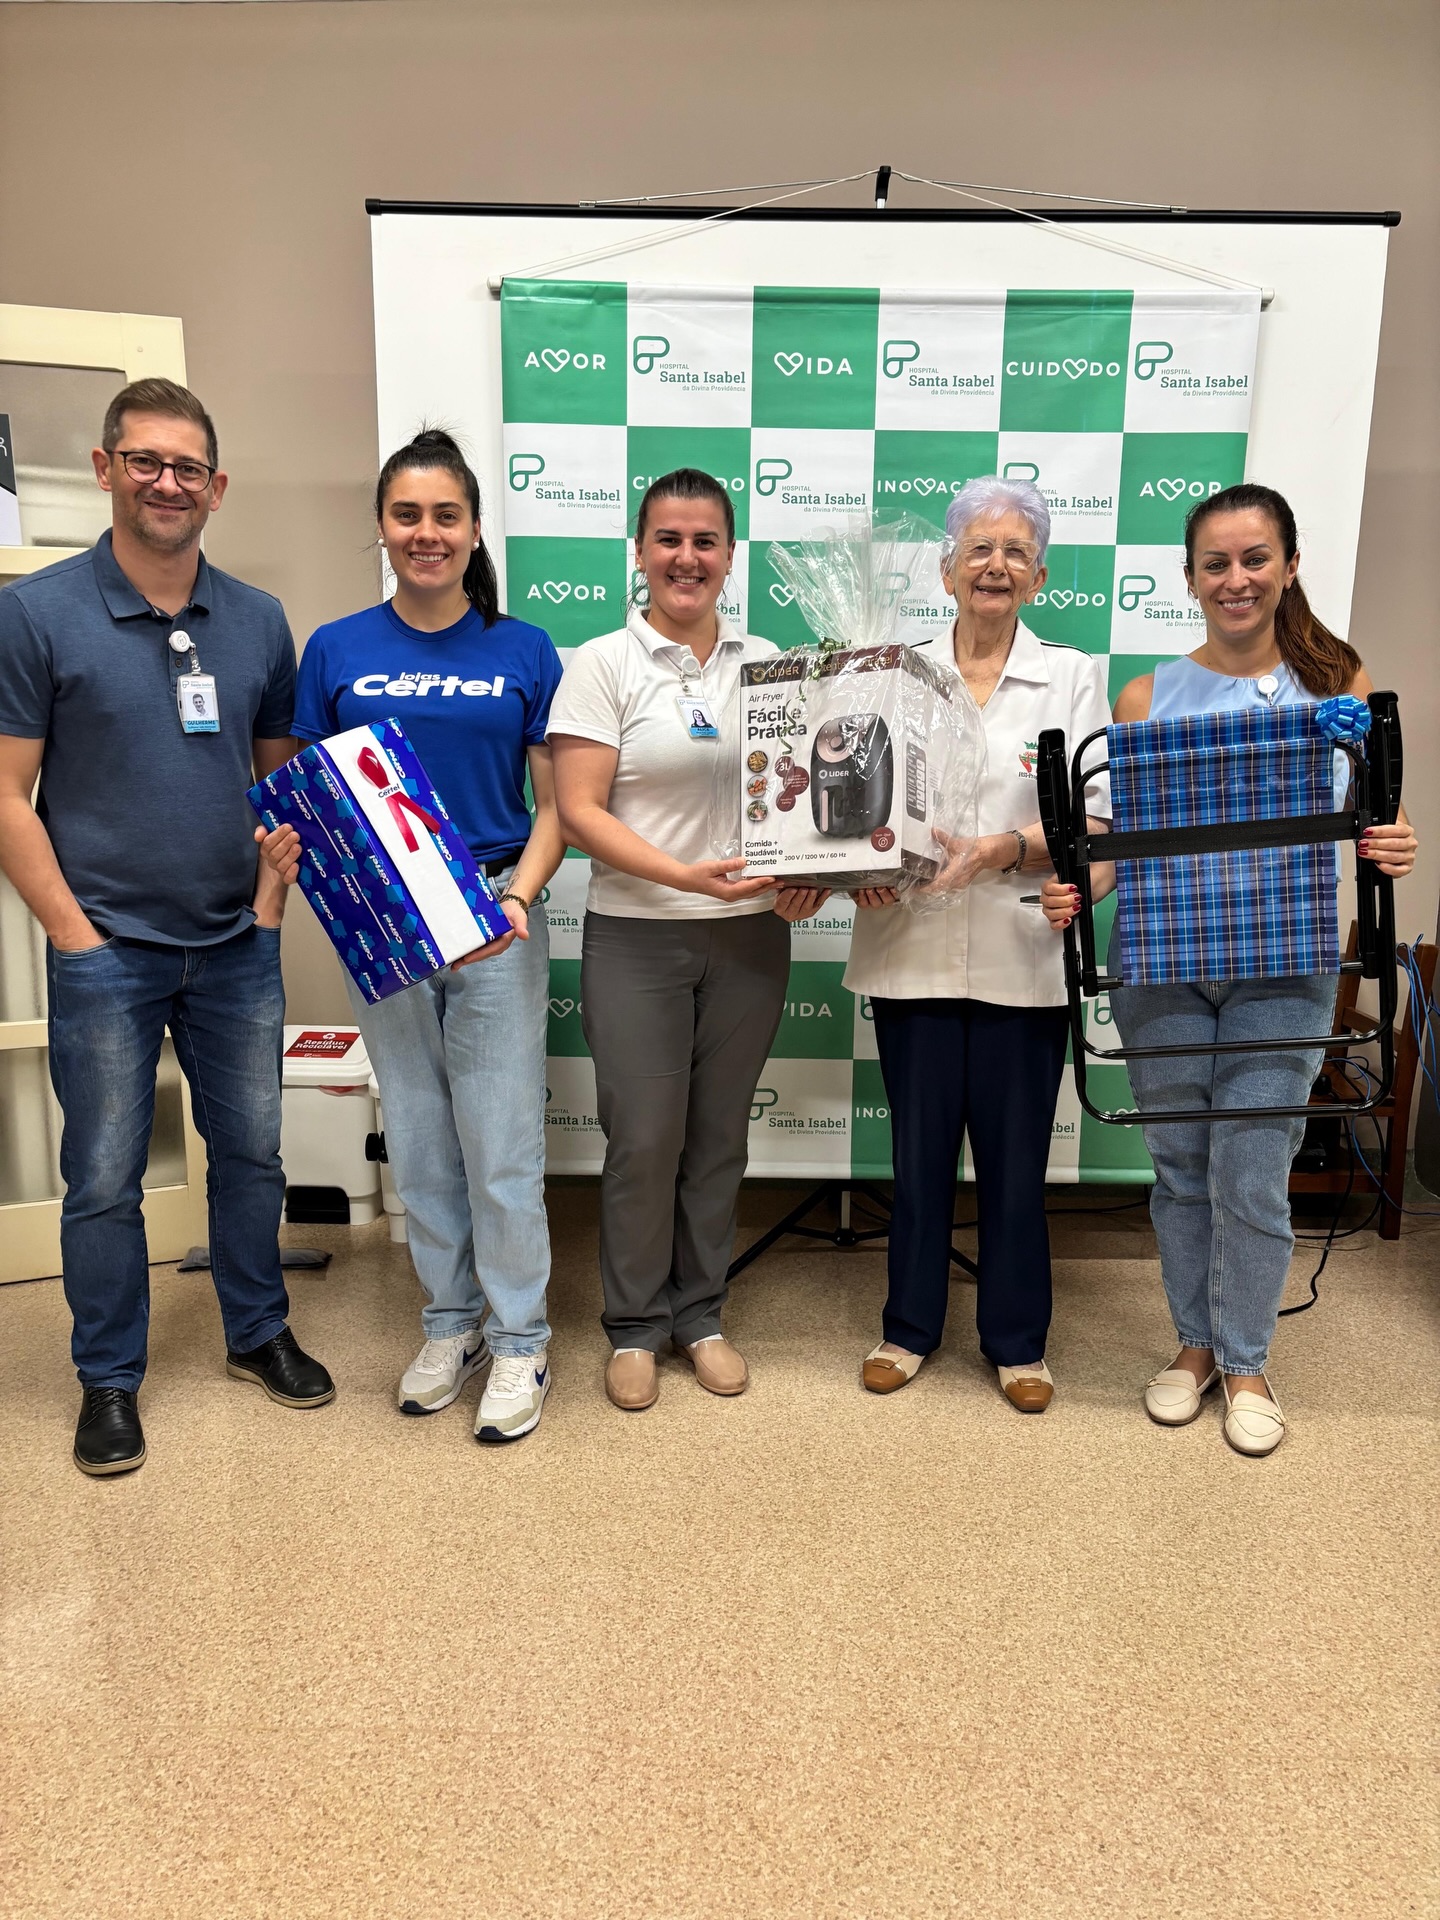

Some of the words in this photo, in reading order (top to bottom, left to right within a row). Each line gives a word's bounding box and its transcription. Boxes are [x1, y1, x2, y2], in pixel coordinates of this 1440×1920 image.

[660, 371, 700, 382] Santa
[704, 371, 746, 384] Isabel
[909, 375, 948, 386] Santa
[952, 375, 994, 387] Isabel
[1160, 376, 1200, 388] Santa
[1205, 375, 1248, 388] Isabel
[536, 488, 574, 500] Santa
[579, 489, 620, 501] Isabel
[782, 493, 820, 504] Santa
[825, 493, 866, 504] Isabel
[1046, 498, 1067, 508] nta
[1072, 496, 1112, 508] Isabel
[900, 606, 938, 616] Santa
[1144, 608, 1183, 619] Santa
[1187, 608, 1206, 619] Isa
[400, 672, 440, 682] lojas
[768, 666, 800, 678] LIDER
[352, 674, 505, 698] Certel
[748, 694, 760, 704] Air
[762, 692, 784, 702] Fryer
[748, 706, 786, 724] Fácil
[791, 708, 802, 719] e
[319, 769, 340, 800] Certel
[378, 784, 400, 798] Certel
[813, 918, 852, 928] Isabel
[544, 1114, 578, 1125] Santa
[582, 1116, 600, 1125] Isa
[768, 1118, 804, 1128] Santa
[808, 1118, 846, 1128] Isabel
